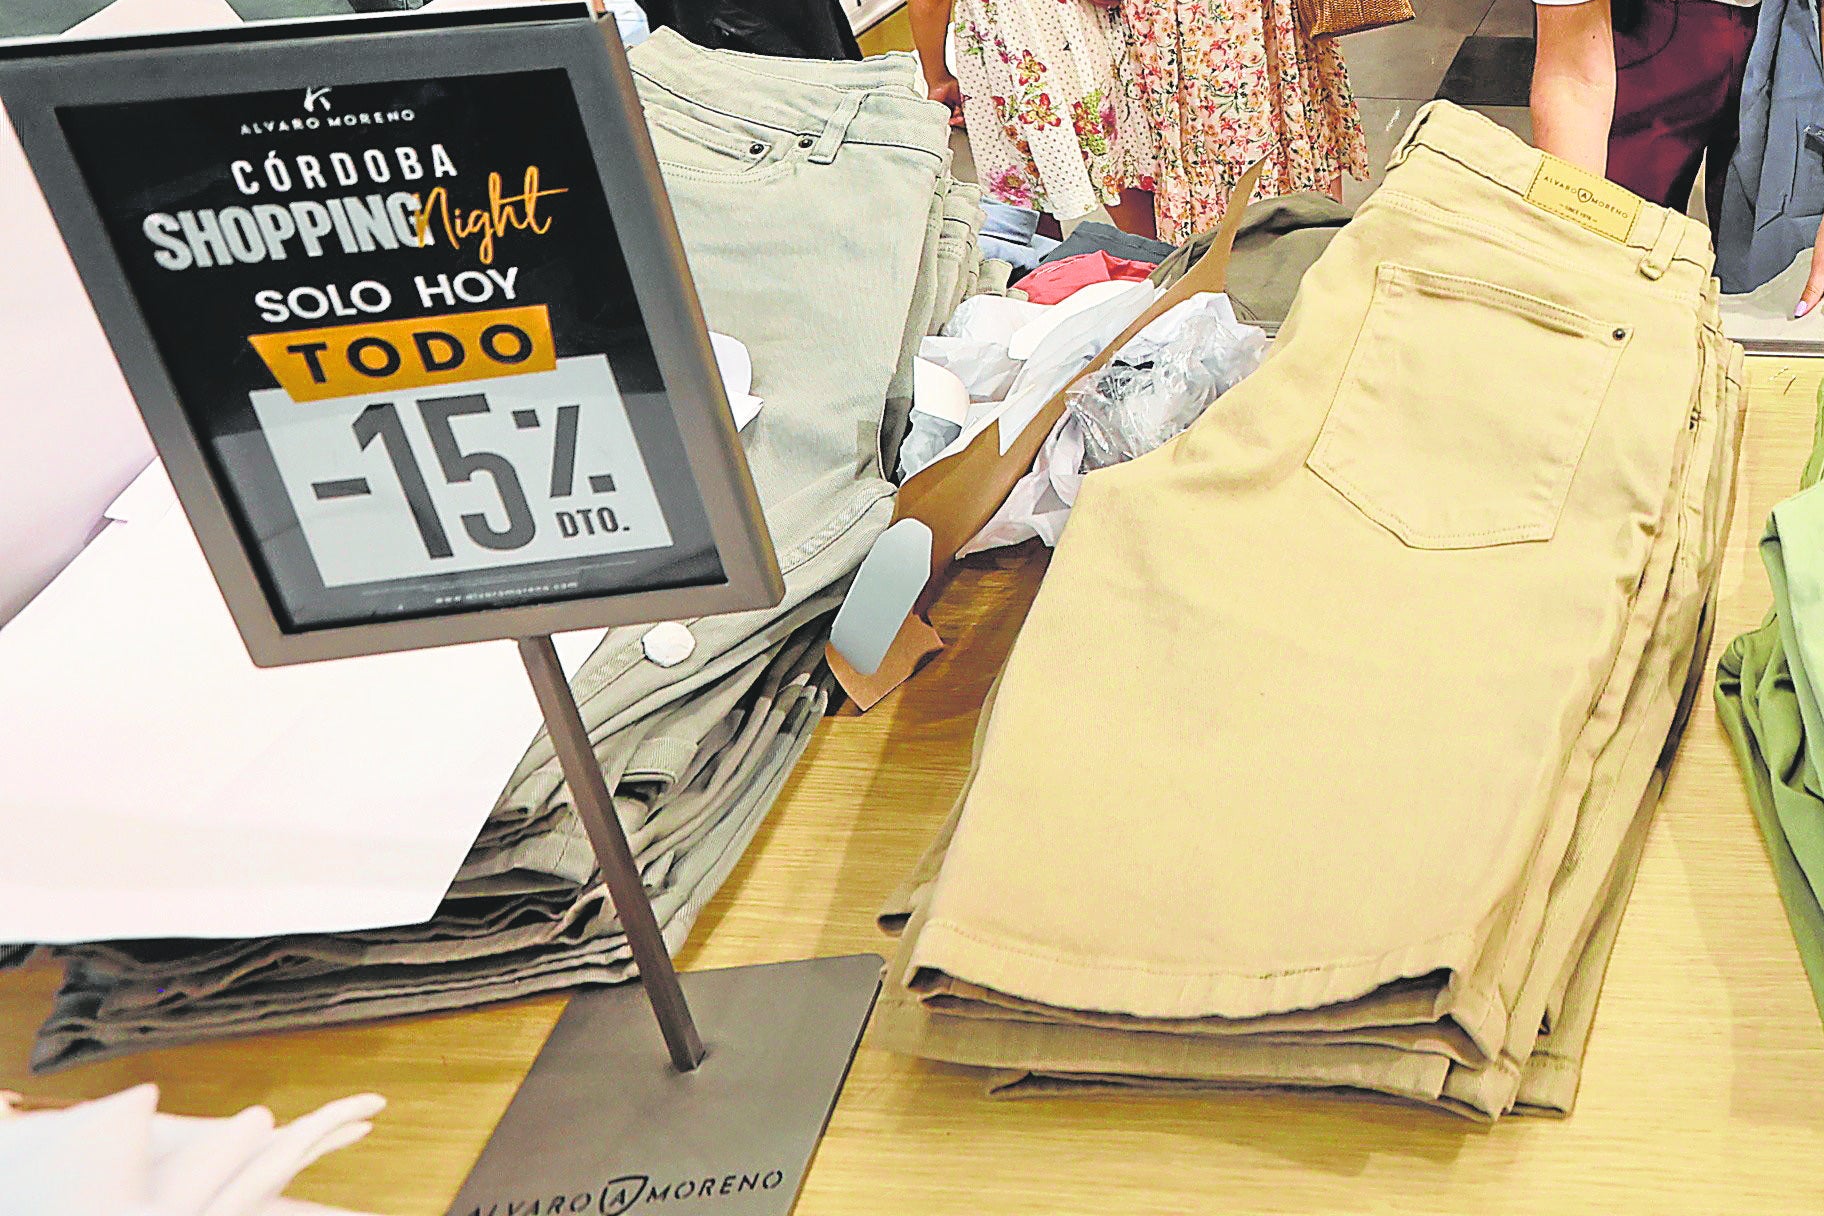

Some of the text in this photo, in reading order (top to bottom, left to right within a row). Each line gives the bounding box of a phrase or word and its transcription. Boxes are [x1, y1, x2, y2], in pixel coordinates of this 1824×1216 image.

[240, 109, 415, 135] ALVARO MORENO
[230, 143, 457, 195] CÓRDOBA
[142, 165, 569, 270] SHOPPING Night
[255, 266, 519, 322] SOLO HOY
[287, 323, 534, 383] TODO
[311, 393, 617, 559] -15%
[555, 507, 631, 540] DTO.
[646, 1170, 784, 1203] MORENO
